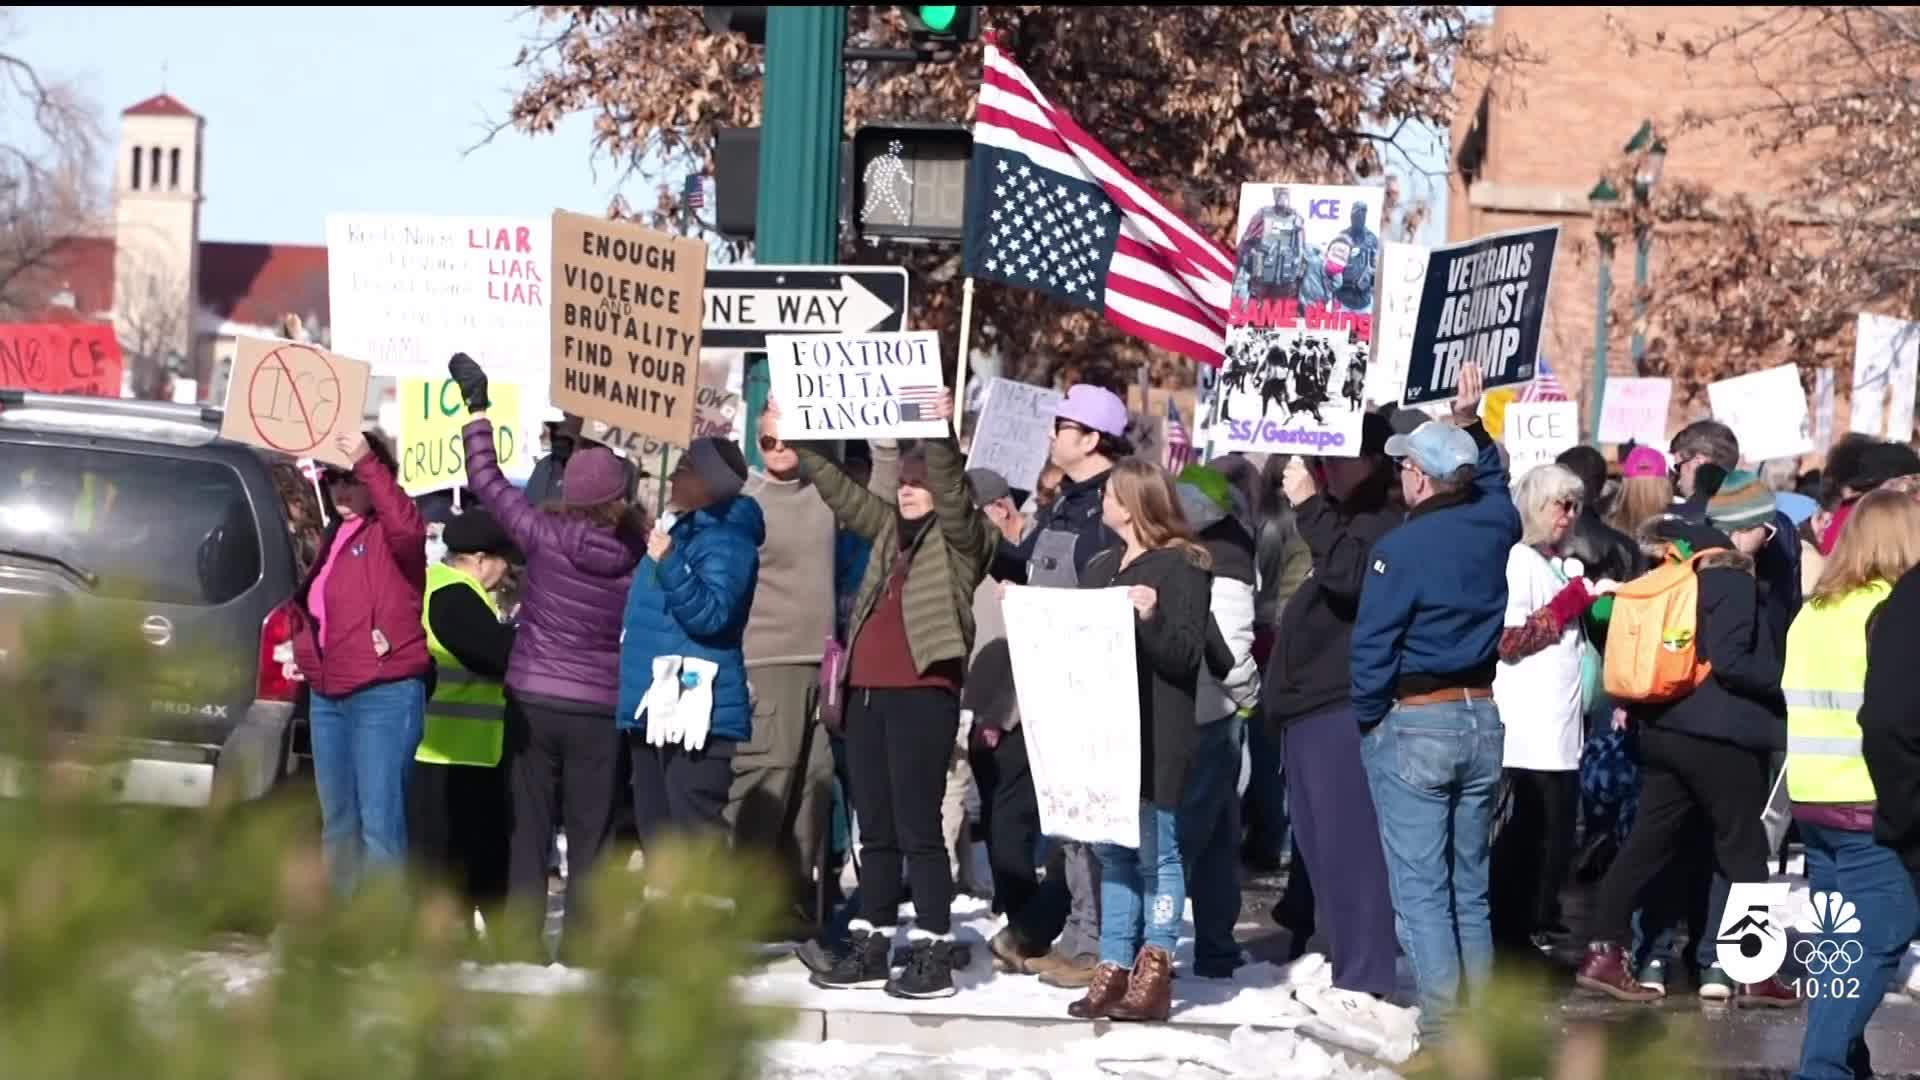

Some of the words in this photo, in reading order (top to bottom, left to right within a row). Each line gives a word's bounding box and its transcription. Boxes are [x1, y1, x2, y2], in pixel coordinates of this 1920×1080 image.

[1309, 199, 1341, 220] ICE
[468, 226, 532, 254] LIAR
[583, 231, 676, 273] ENOUGH
[488, 258, 543, 283] LIAR
[1447, 242, 1535, 292] VETERANS
[487, 281, 543, 307] LIAR
[564, 263, 681, 315] VIOLENCE
[600, 296, 632, 316] AND
[701, 295, 756, 324] NE
[778, 295, 849, 325] WAY
[1228, 296, 1299, 328] SAME
[1435, 281, 1530, 339] AGAINST
[564, 303, 695, 357] BRUTALITY
[564, 335, 613, 368] FIND
[628, 351, 687, 387] YOUR
[792, 339, 929, 367] FOXTROT
[1430, 327, 1521, 391] TRUMP
[424, 377, 492, 420] IC
[564, 367, 677, 418] HUMANITY
[796, 372, 894, 399] DELTA
[797, 399, 901, 431] TANGO
[1516, 412, 1562, 441] ICE
[1228, 419, 1345, 451] SS/Gestapo
[403, 425, 514, 484] CRUSD
[151, 701, 229, 719] PRO-4X
